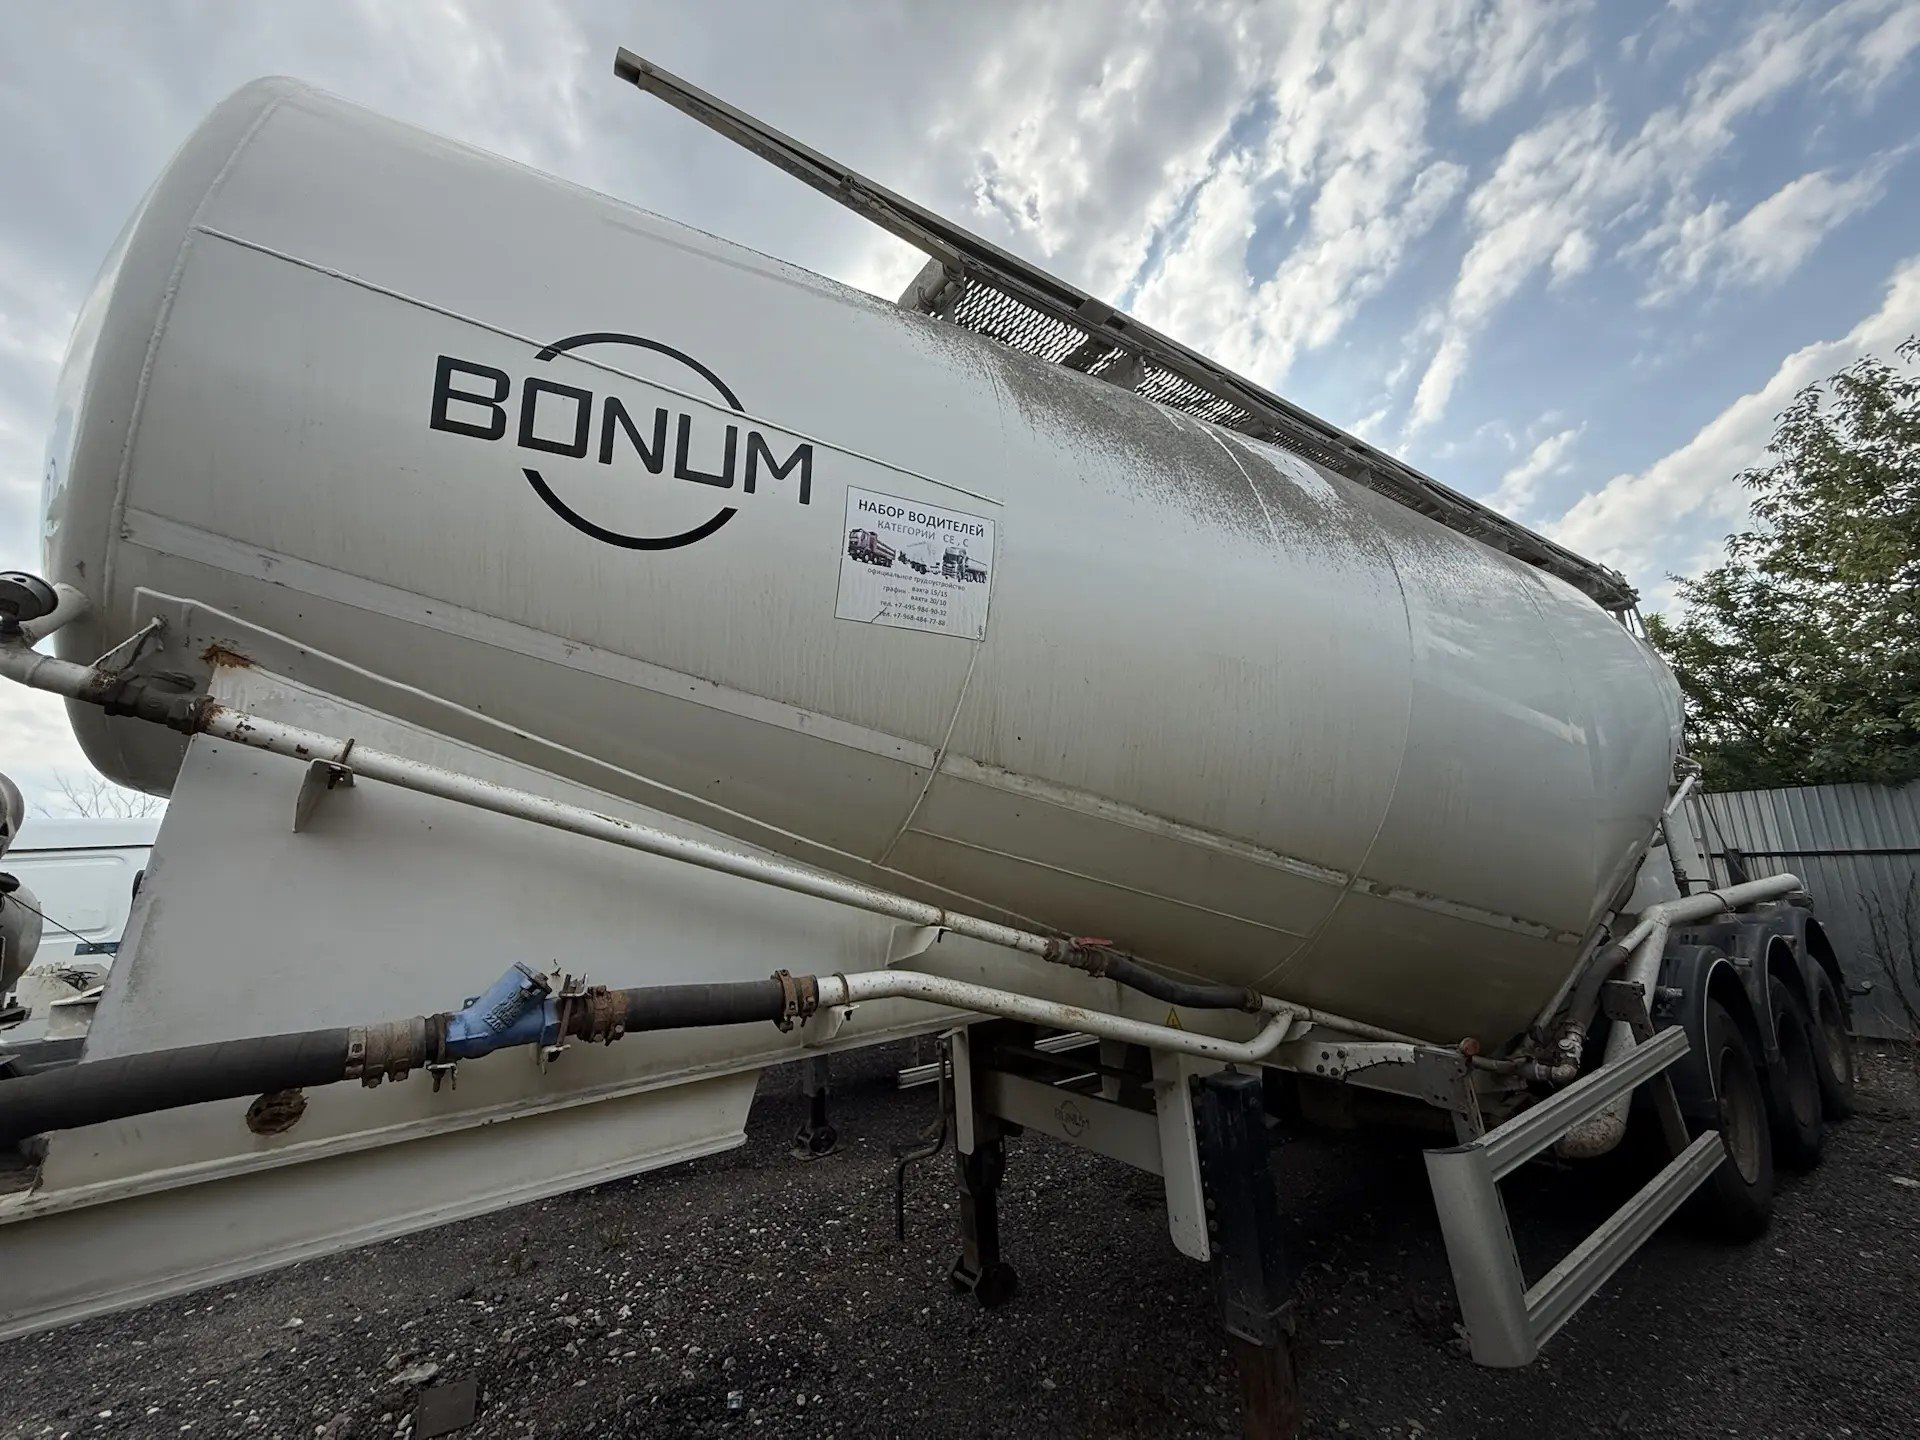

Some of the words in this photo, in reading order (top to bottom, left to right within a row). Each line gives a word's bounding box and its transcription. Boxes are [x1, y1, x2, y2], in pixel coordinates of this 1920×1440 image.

[430, 354, 813, 505] BONUM
[858, 499, 905, 518] НАБОР
[908, 511, 984, 537] ВОДИТЕЛЕЙ
[877, 520, 936, 540] КАТЕГОРИИ
[867, 568, 912, 579] официальное
[914, 577, 966, 591] трудоустройство
[910, 595, 928, 603] вахта
[911, 587, 929, 595] вахта
[930, 588, 948, 598] 15/15
